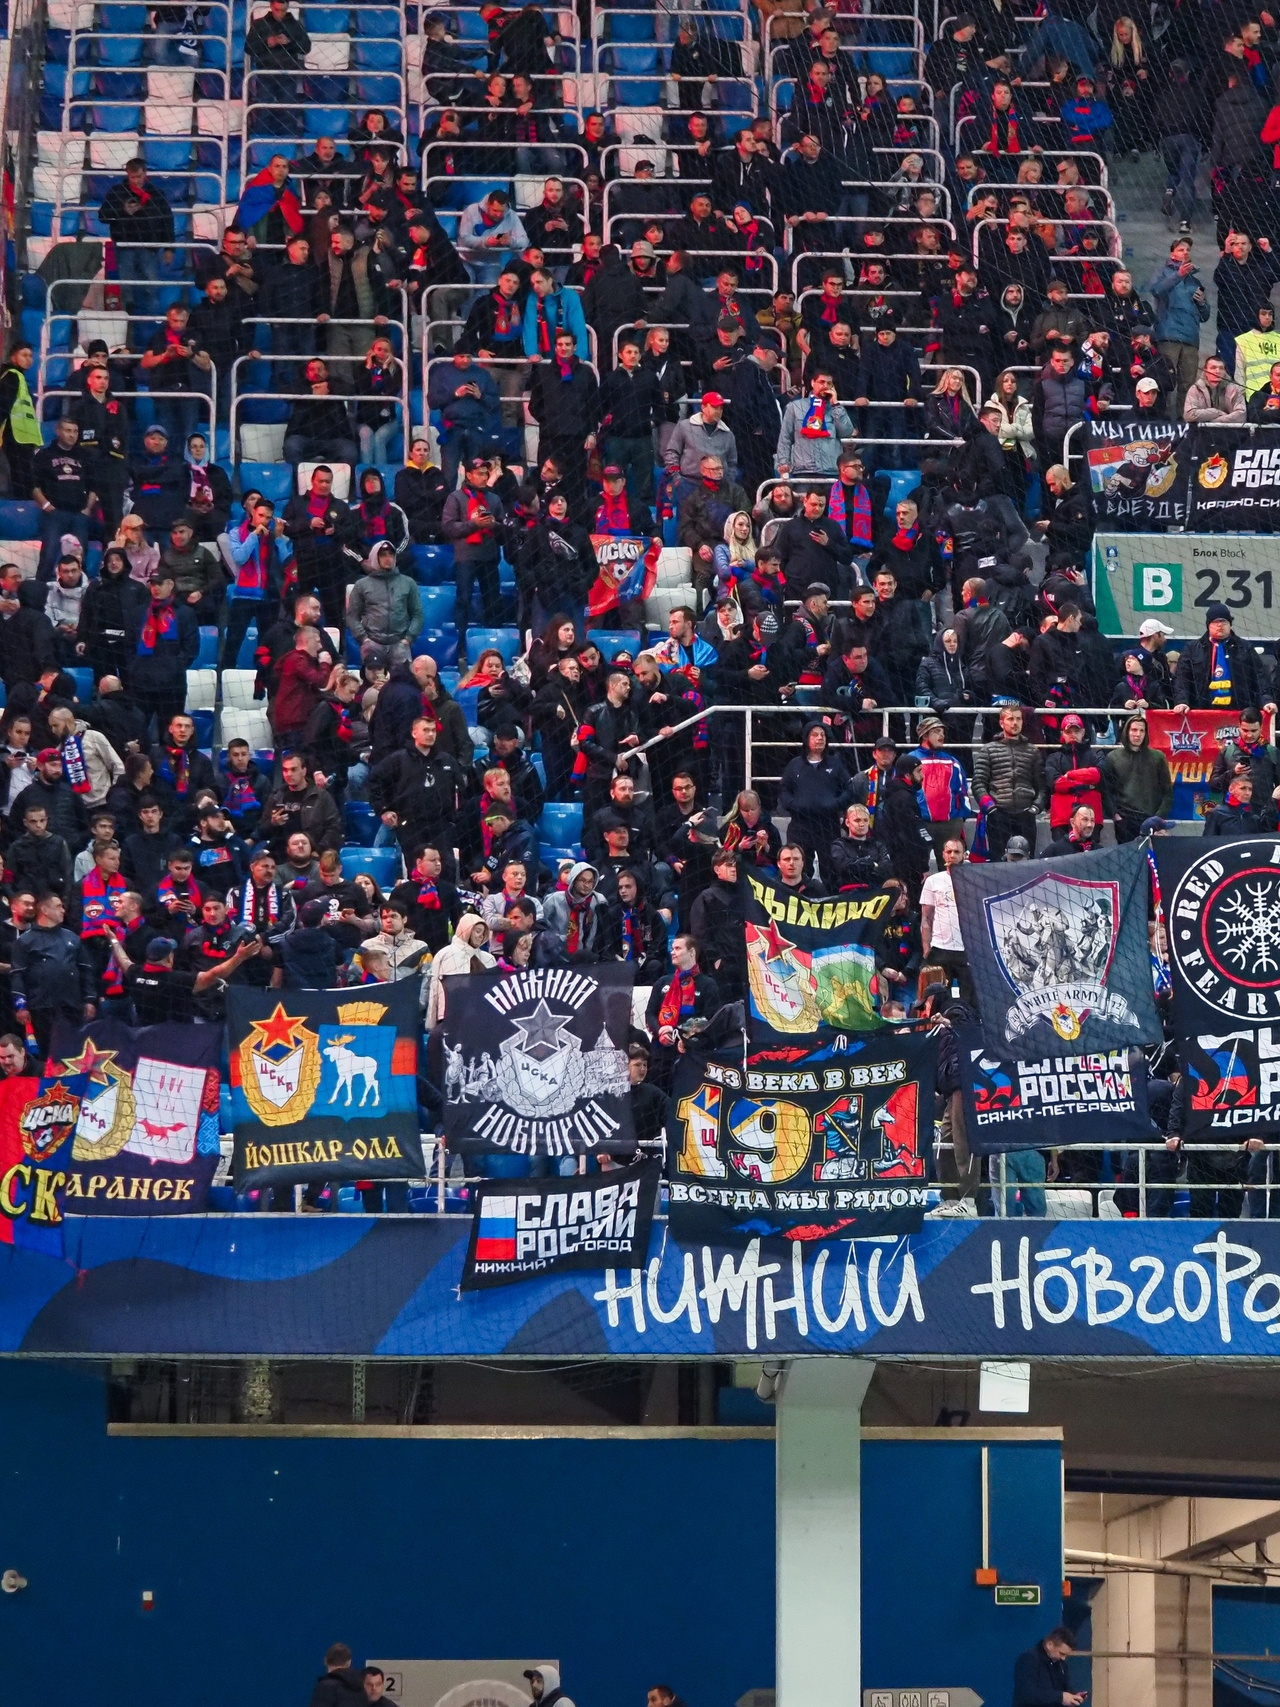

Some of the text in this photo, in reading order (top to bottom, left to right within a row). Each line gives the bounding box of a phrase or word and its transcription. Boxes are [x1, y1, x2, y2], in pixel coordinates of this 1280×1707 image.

[1193, 548, 1246, 558] Блок Block
[1194, 569, 1272, 608] 231
[1176, 860, 1225, 921] RED
[484, 968, 599, 1016] НИЖНИЙ
[1023, 989, 1100, 1011] WHITE ARMY
[260, 1063, 293, 1093] ЦСКА
[706, 1060, 906, 1092] ИЗ ВЕКА В ВЕК
[22, 1104, 73, 1131] ЦСКА
[80, 1105, 107, 1130] СКА
[472, 1100, 620, 1156] НОВГОРОД
[977, 1101, 1136, 1126] САНКТ-ПЕТЕРБУРГ
[675, 1081, 926, 1186] 1911
[245, 1135, 403, 1169] ЙОШКАР-ОЛА
[65, 1173, 194, 1200] АРАНСК
[668, 1182, 929, 1213] ВСЕГДА МЫ РЯДОМ
[516, 1178, 642, 1229] СЛАВА
[516, 1208, 638, 1260] РОССИИ
[474, 1258, 547, 1274] НИЖНИЙ
